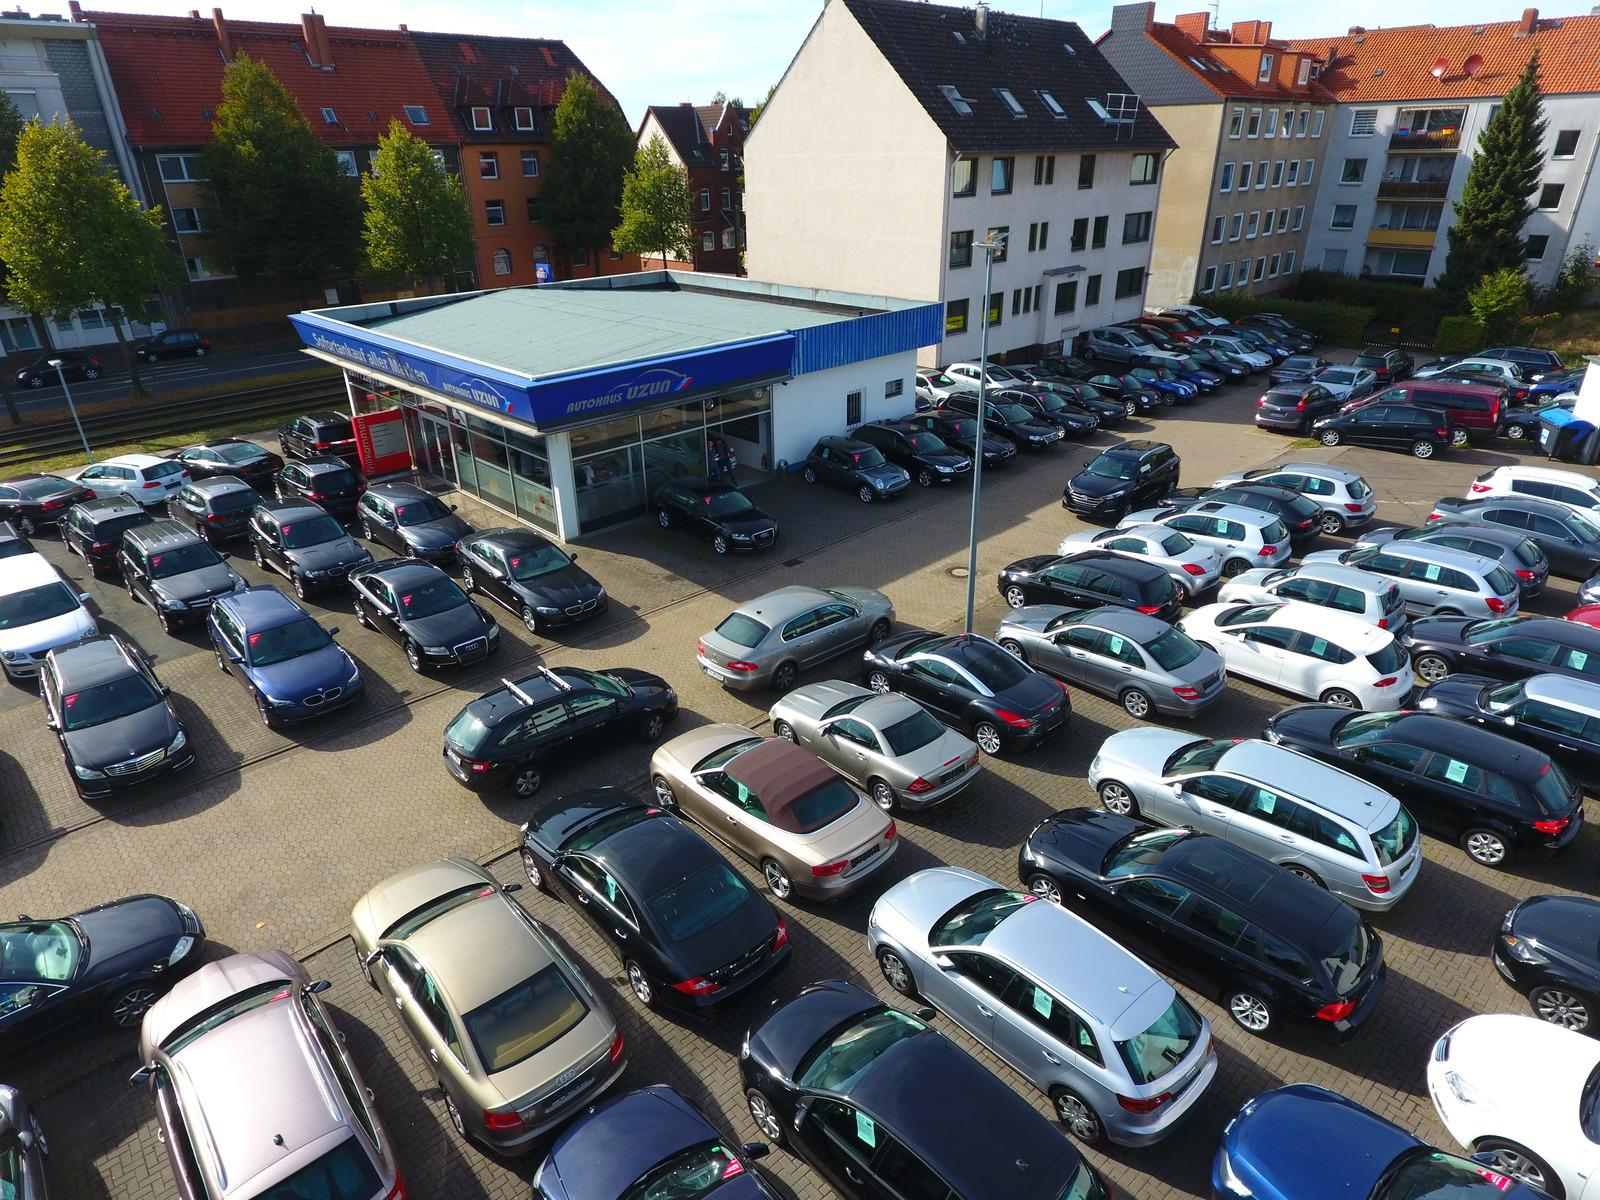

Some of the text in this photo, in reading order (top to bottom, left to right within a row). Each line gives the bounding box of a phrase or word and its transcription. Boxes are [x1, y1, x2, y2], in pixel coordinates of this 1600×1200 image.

[312, 332, 367, 362] Sofortankauf
[367, 350, 388, 370] aller
[442, 381, 500, 408] AUTOHAUS UZUN
[566, 379, 671, 413] AUTOHAUS UZUN
[358, 417, 375, 476] Willkommen
